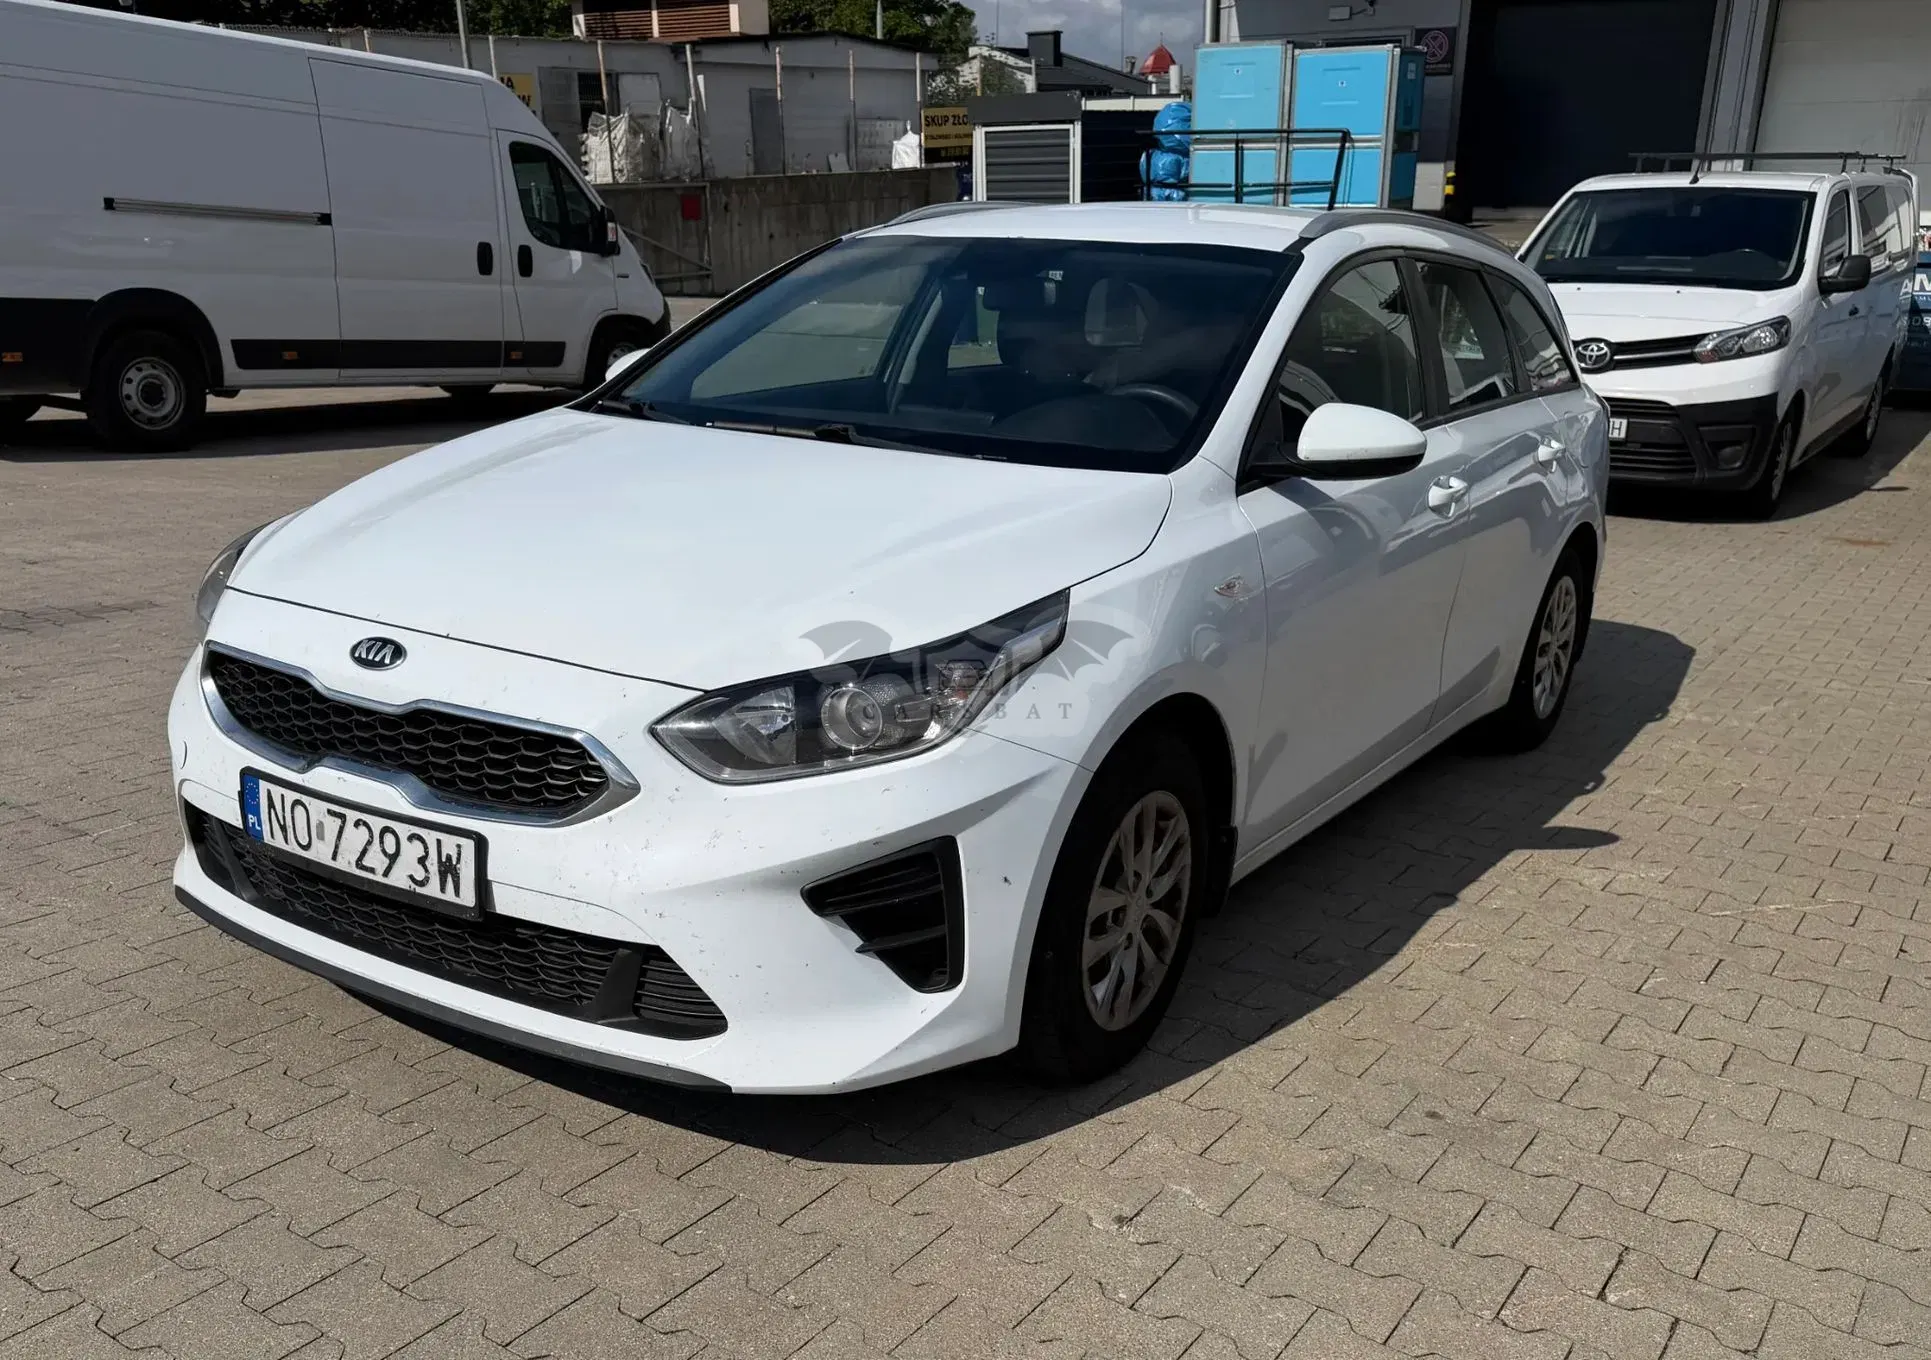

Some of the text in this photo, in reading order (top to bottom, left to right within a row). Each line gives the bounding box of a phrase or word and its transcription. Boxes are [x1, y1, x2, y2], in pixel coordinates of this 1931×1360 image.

[924, 114, 949, 127] SKUP
[354, 639, 395, 665] KIA
[248, 814, 261, 830] PL
[266, 788, 462, 898] NO 7293W
